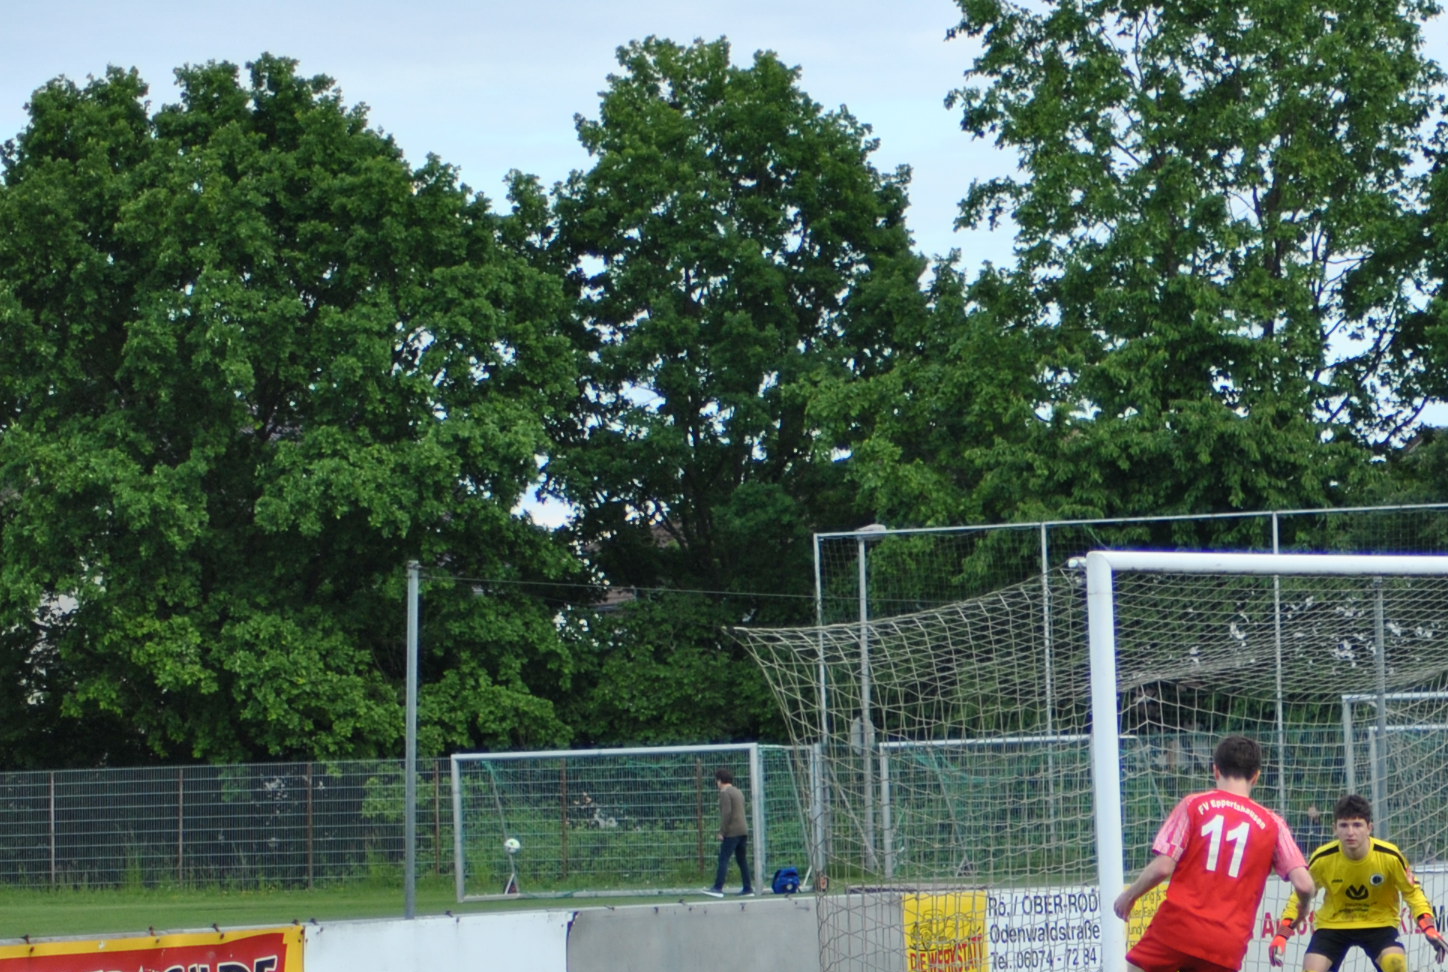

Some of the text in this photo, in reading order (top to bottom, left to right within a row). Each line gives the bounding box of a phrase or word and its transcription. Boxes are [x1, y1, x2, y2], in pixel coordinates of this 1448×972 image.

[1201, 814, 1250, 878] 11
[1021, 892, 1102, 915] OBER-ROD
[989, 920, 1100, 944] Odenwaldstraße
[991, 950, 1012, 970] Tel.
[1016, 949, 1054, 970] 06074
[1066, 948, 1080, 967] 72
[1083, 947, 1097, 965] 84
